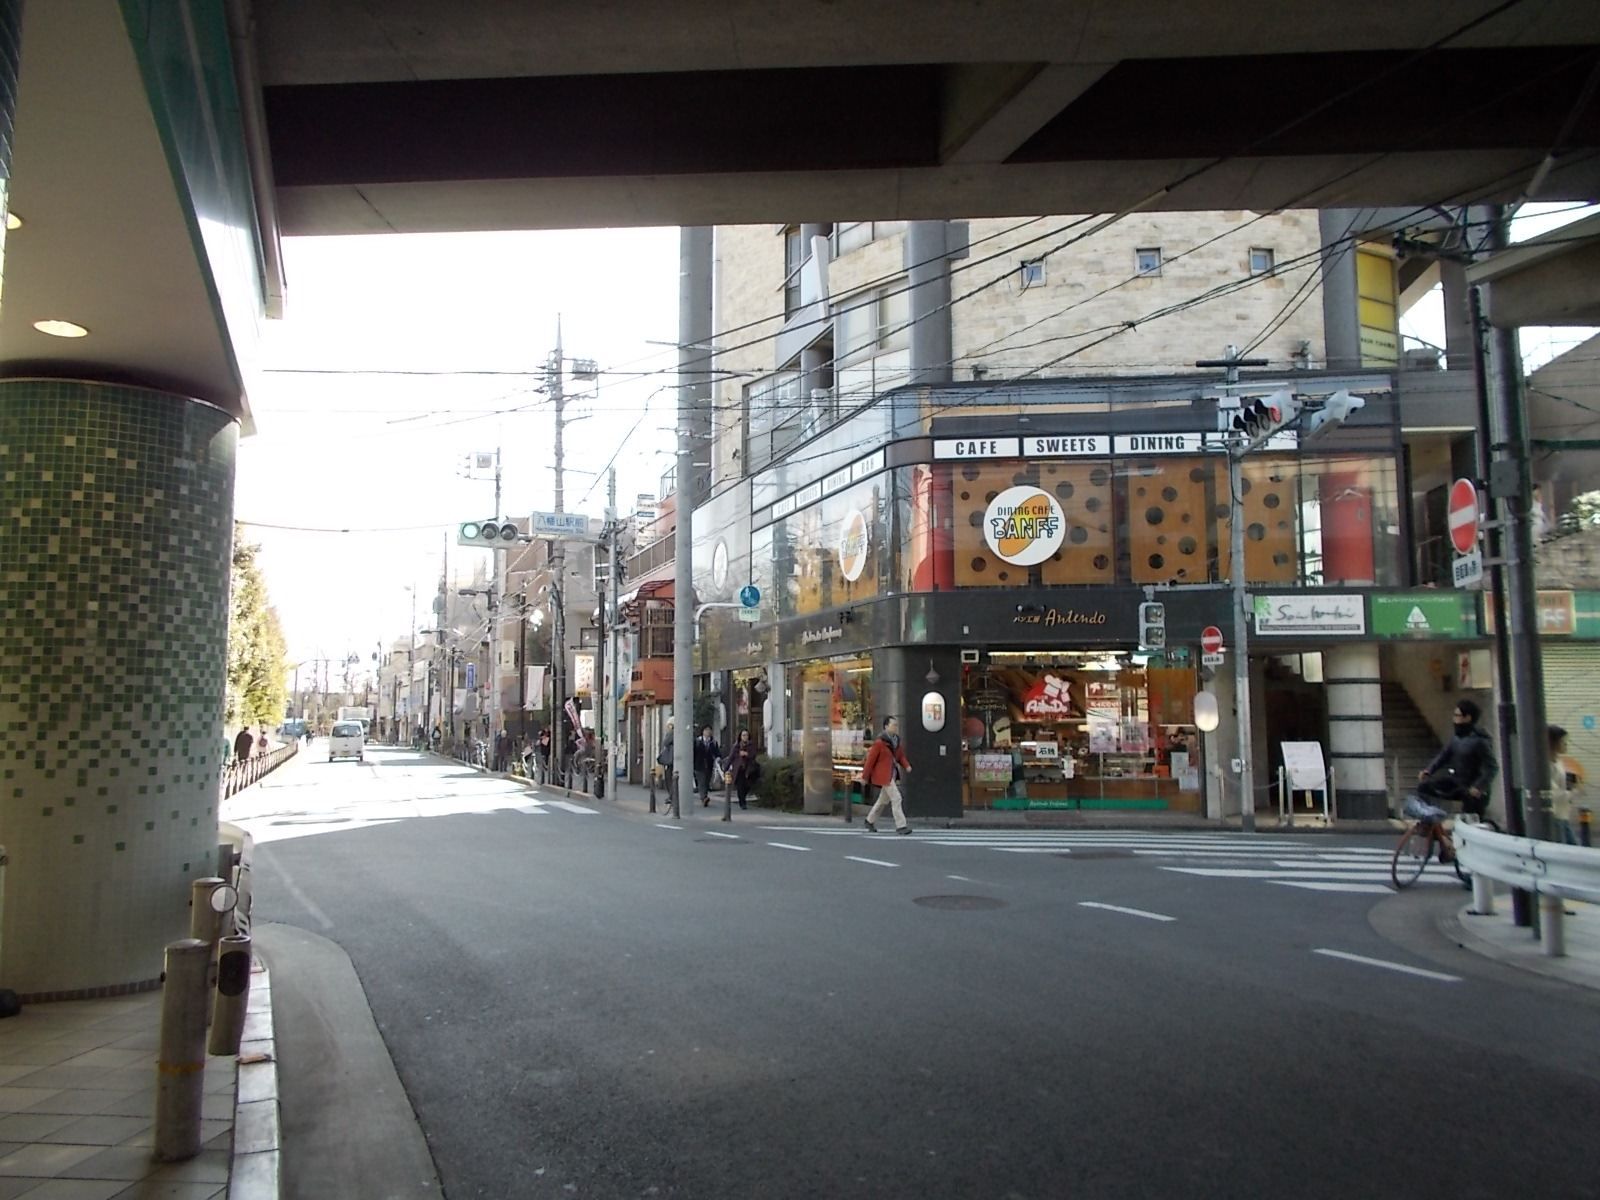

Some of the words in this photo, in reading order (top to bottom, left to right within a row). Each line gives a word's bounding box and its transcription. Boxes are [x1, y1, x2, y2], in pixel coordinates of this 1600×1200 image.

[955, 440, 998, 455] CAFE
[1036, 437, 1097, 453] SWEETS
[1130, 435, 1186, 451] DINING
[997, 506, 1030, 516] DINING
[1032, 505, 1056, 515] CAFE
[990, 516, 1059, 540] BANFF
